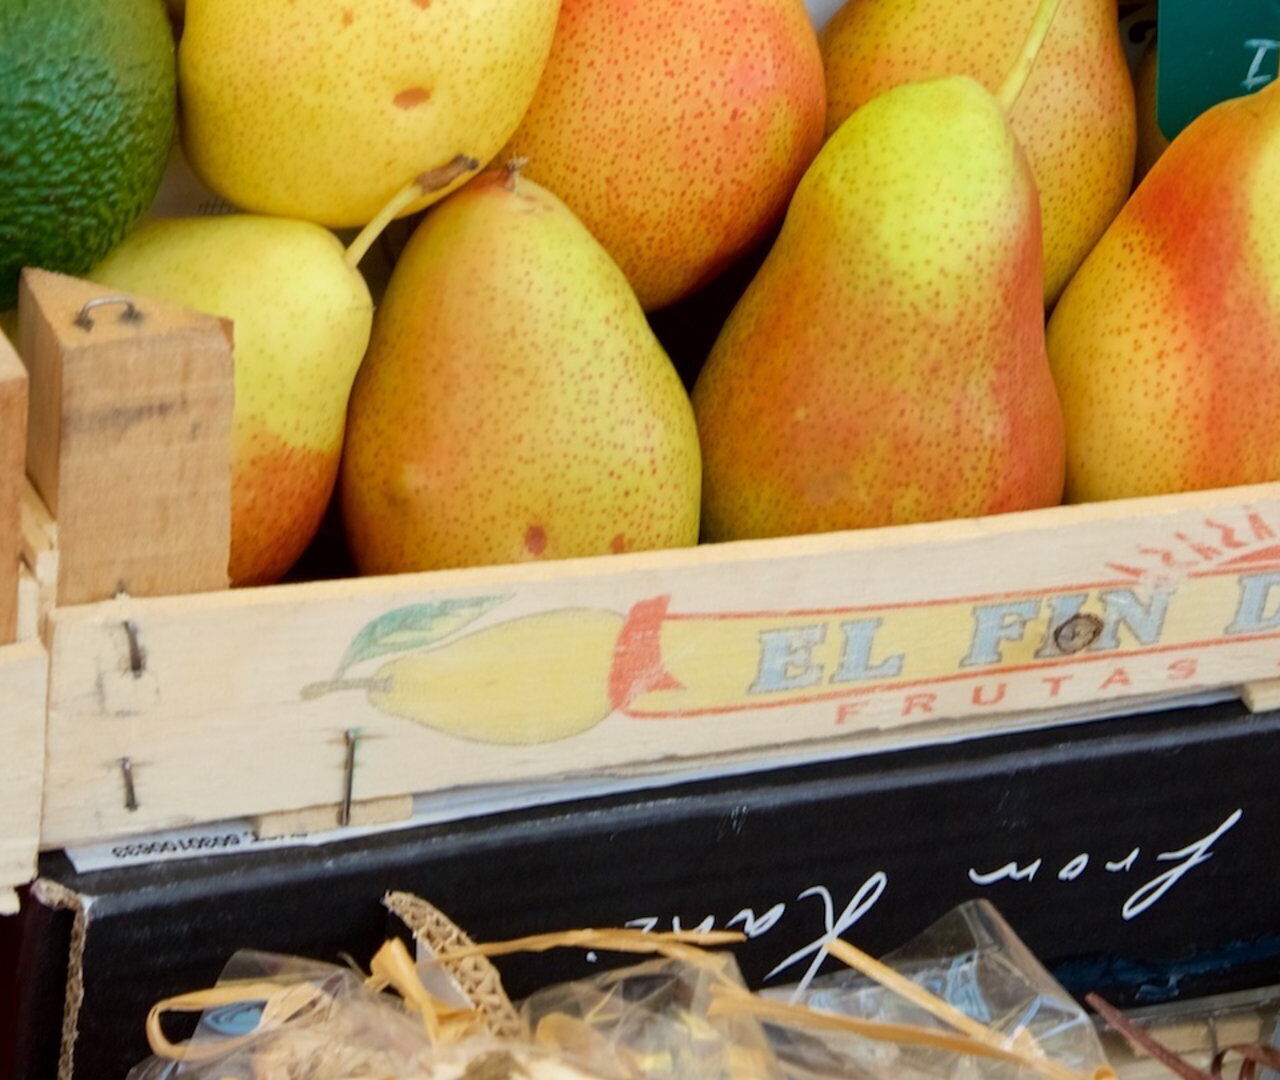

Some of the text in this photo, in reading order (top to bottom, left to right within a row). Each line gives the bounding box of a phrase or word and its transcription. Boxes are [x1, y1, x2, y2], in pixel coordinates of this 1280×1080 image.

[746, 617, 906, 696] EL
[958, 585, 1178, 669] FIN
[834, 657, 1200, 726] FRUTAS
[968, 808, 1244, 920] from
